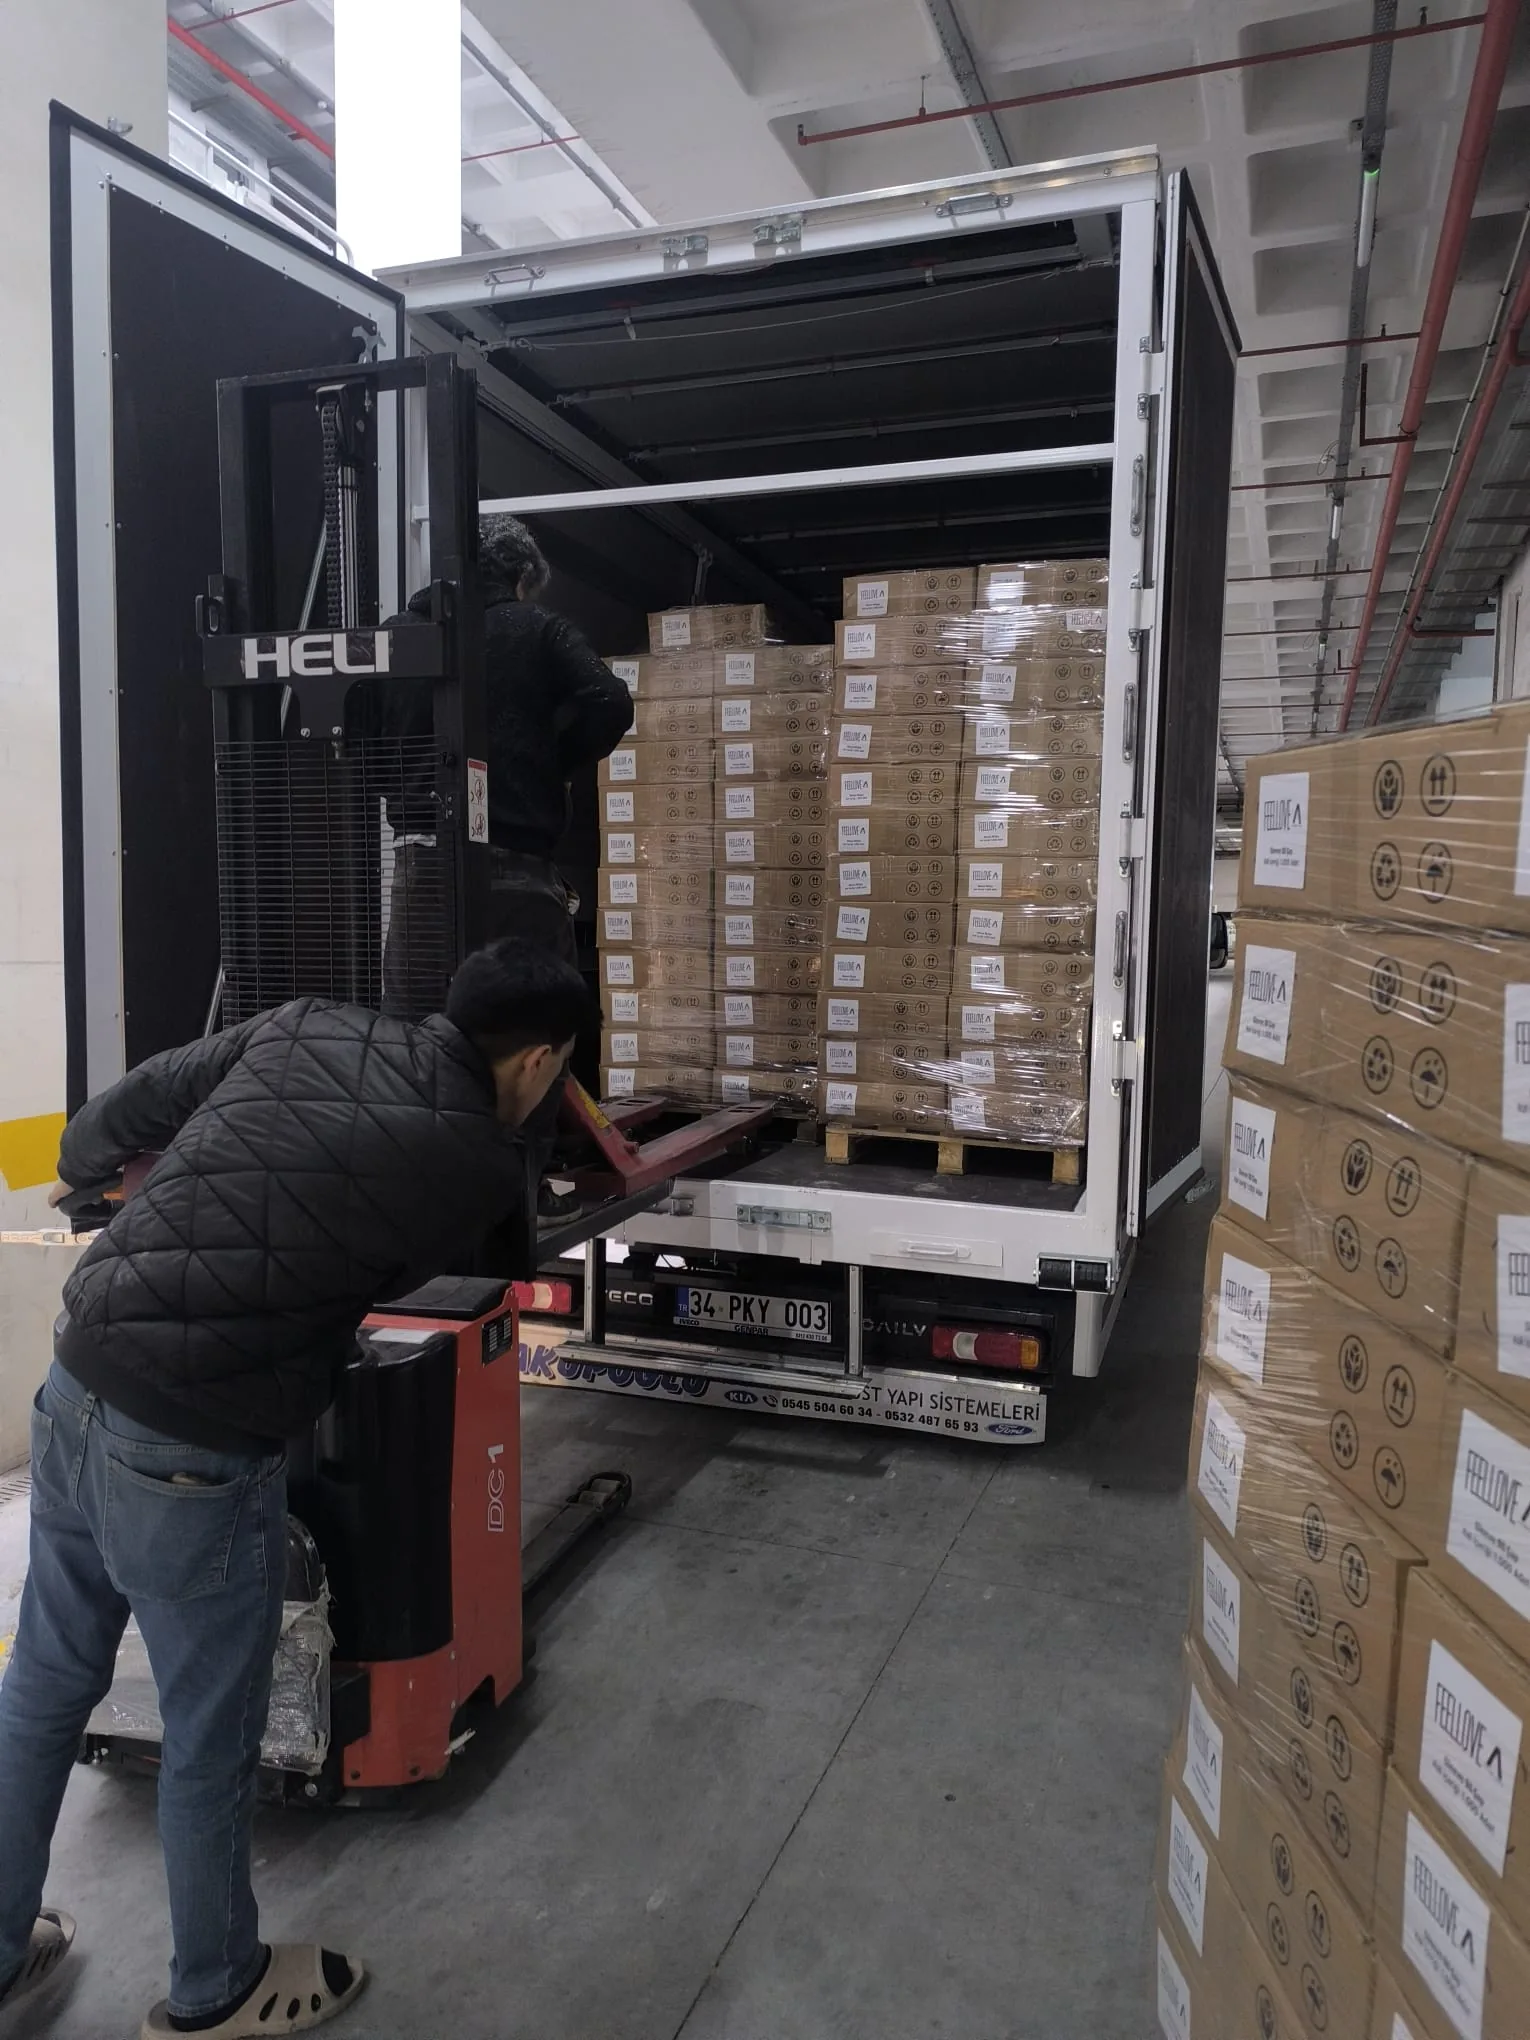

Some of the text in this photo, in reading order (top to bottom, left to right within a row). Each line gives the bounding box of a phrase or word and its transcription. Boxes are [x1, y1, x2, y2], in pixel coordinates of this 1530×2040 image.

[244, 631, 390, 680] HELI
[605, 1289, 654, 1306] ECO
[690, 1290, 716, 1318] 34
[729, 1295, 770, 1324] PKY
[785, 1301, 826, 1331] 003
[729, 1391, 754, 1403] KIA
[782, 1398, 810, 1411] 0545
[814, 1402, 836, 1413] 504
[839, 1405, 854, 1416] 60
[858, 1407, 873, 1418] 34
[885, 1410, 915, 1423] 0532
[918, 1414, 940, 1427] 487
[944, 1418, 960, 1430] 65
[963, 1421, 979, 1433] 93
[888, 1388, 923, 1408] YAPI
[930, 1391, 1040, 1421] SİSTEMELERİ
[995, 1423, 1025, 1436] Ford
[1465, 1448, 1523, 1525] FEELLOVE
[1434, 1682, 1488, 1768] FEELLOVE
[1414, 1855, 1460, 1949] FEELLOVE
